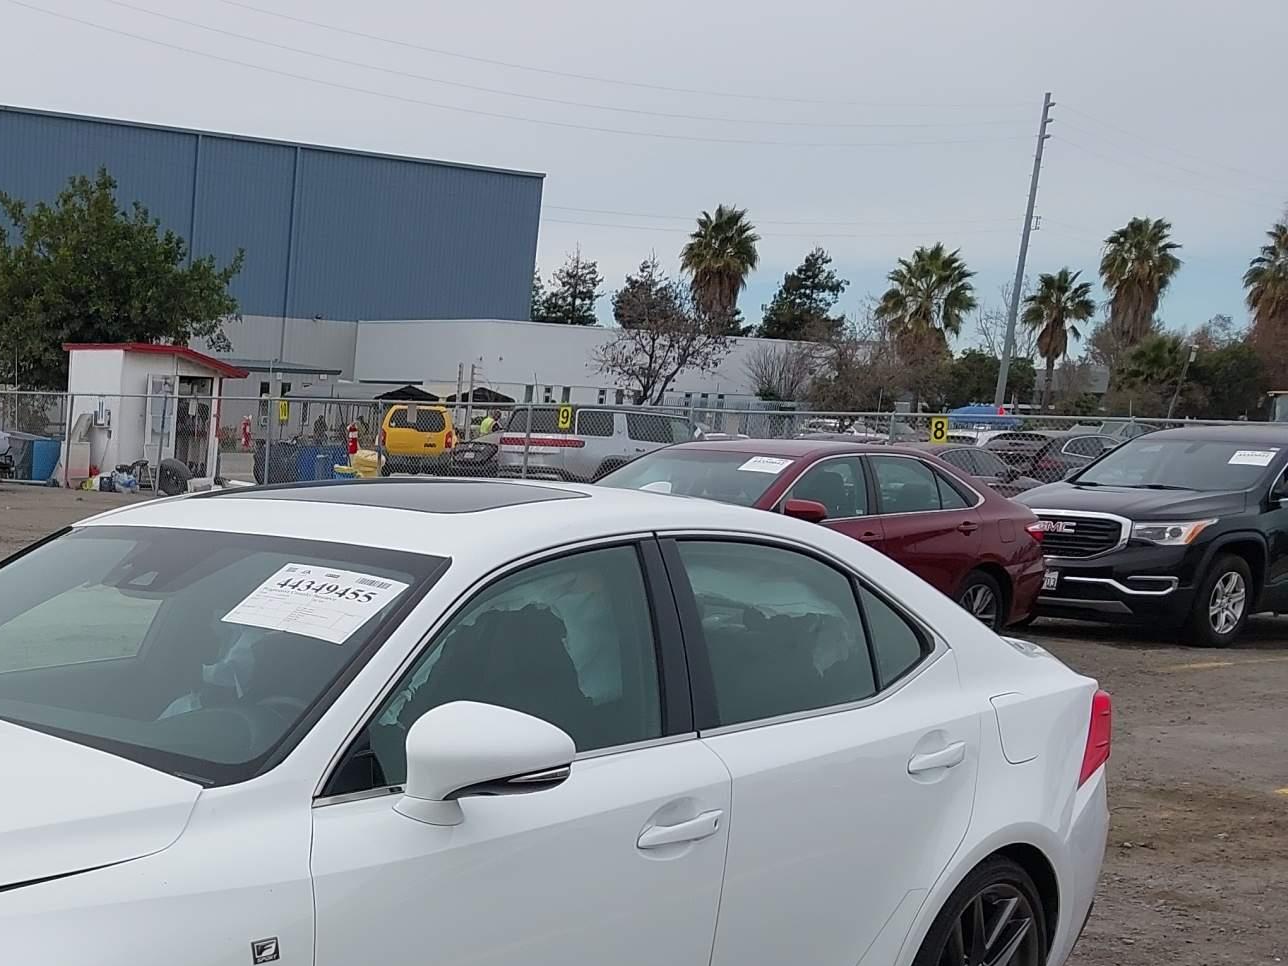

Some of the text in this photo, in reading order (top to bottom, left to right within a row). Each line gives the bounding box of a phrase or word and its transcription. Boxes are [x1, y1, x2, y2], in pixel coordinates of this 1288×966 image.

[560, 408, 570, 425] 9
[933, 420, 945, 440] 8
[276, 577, 378, 603] 44349455
